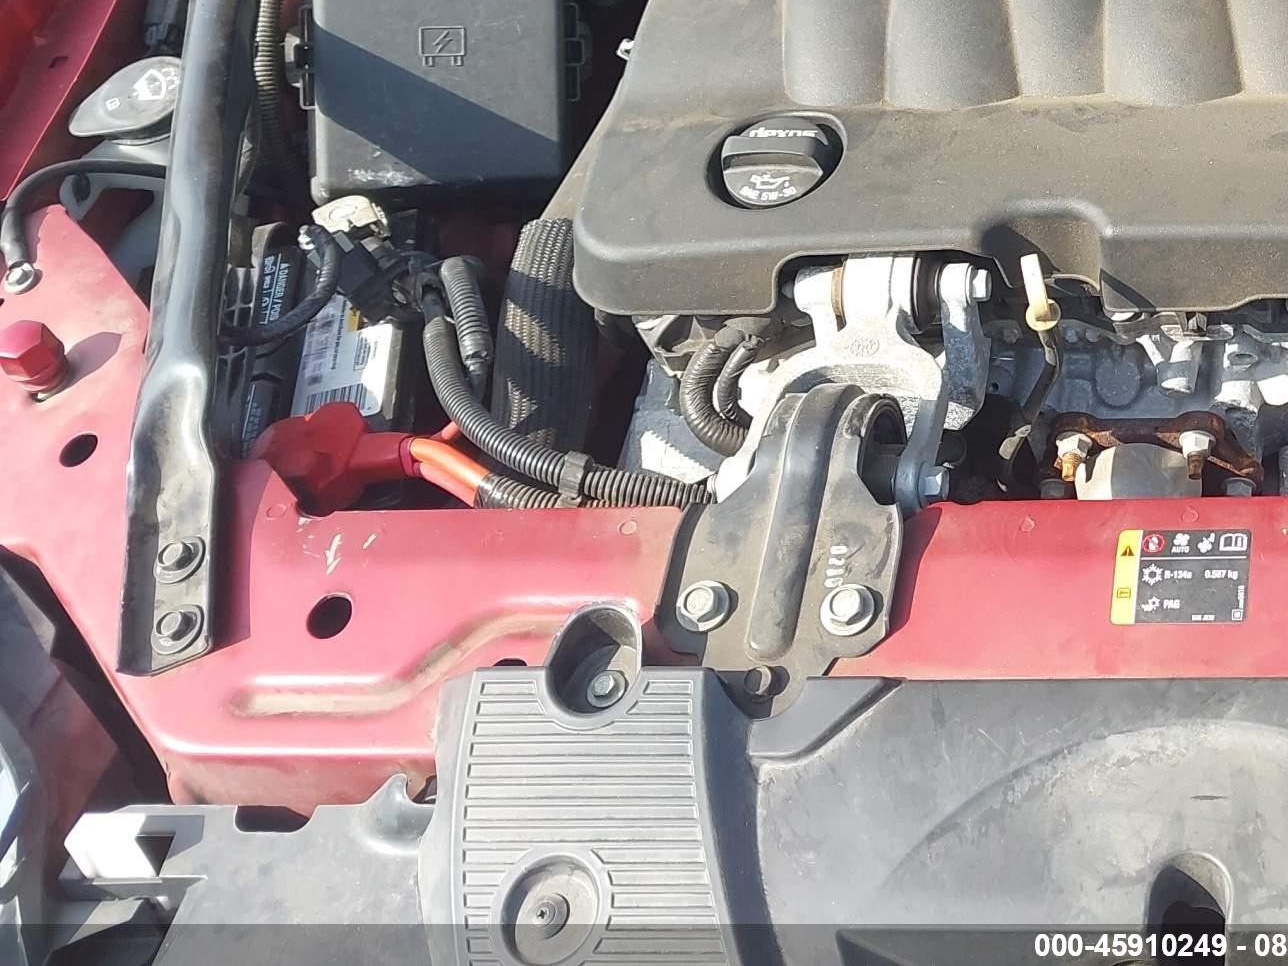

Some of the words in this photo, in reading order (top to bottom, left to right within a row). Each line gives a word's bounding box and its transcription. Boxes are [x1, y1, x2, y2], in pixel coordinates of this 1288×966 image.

[275, 268, 288, 297] DANGER
[1170, 545, 1190, 554] AUTO
[1227, 569, 1239, 581] kg
[1163, 599, 1181, 610] PAG
